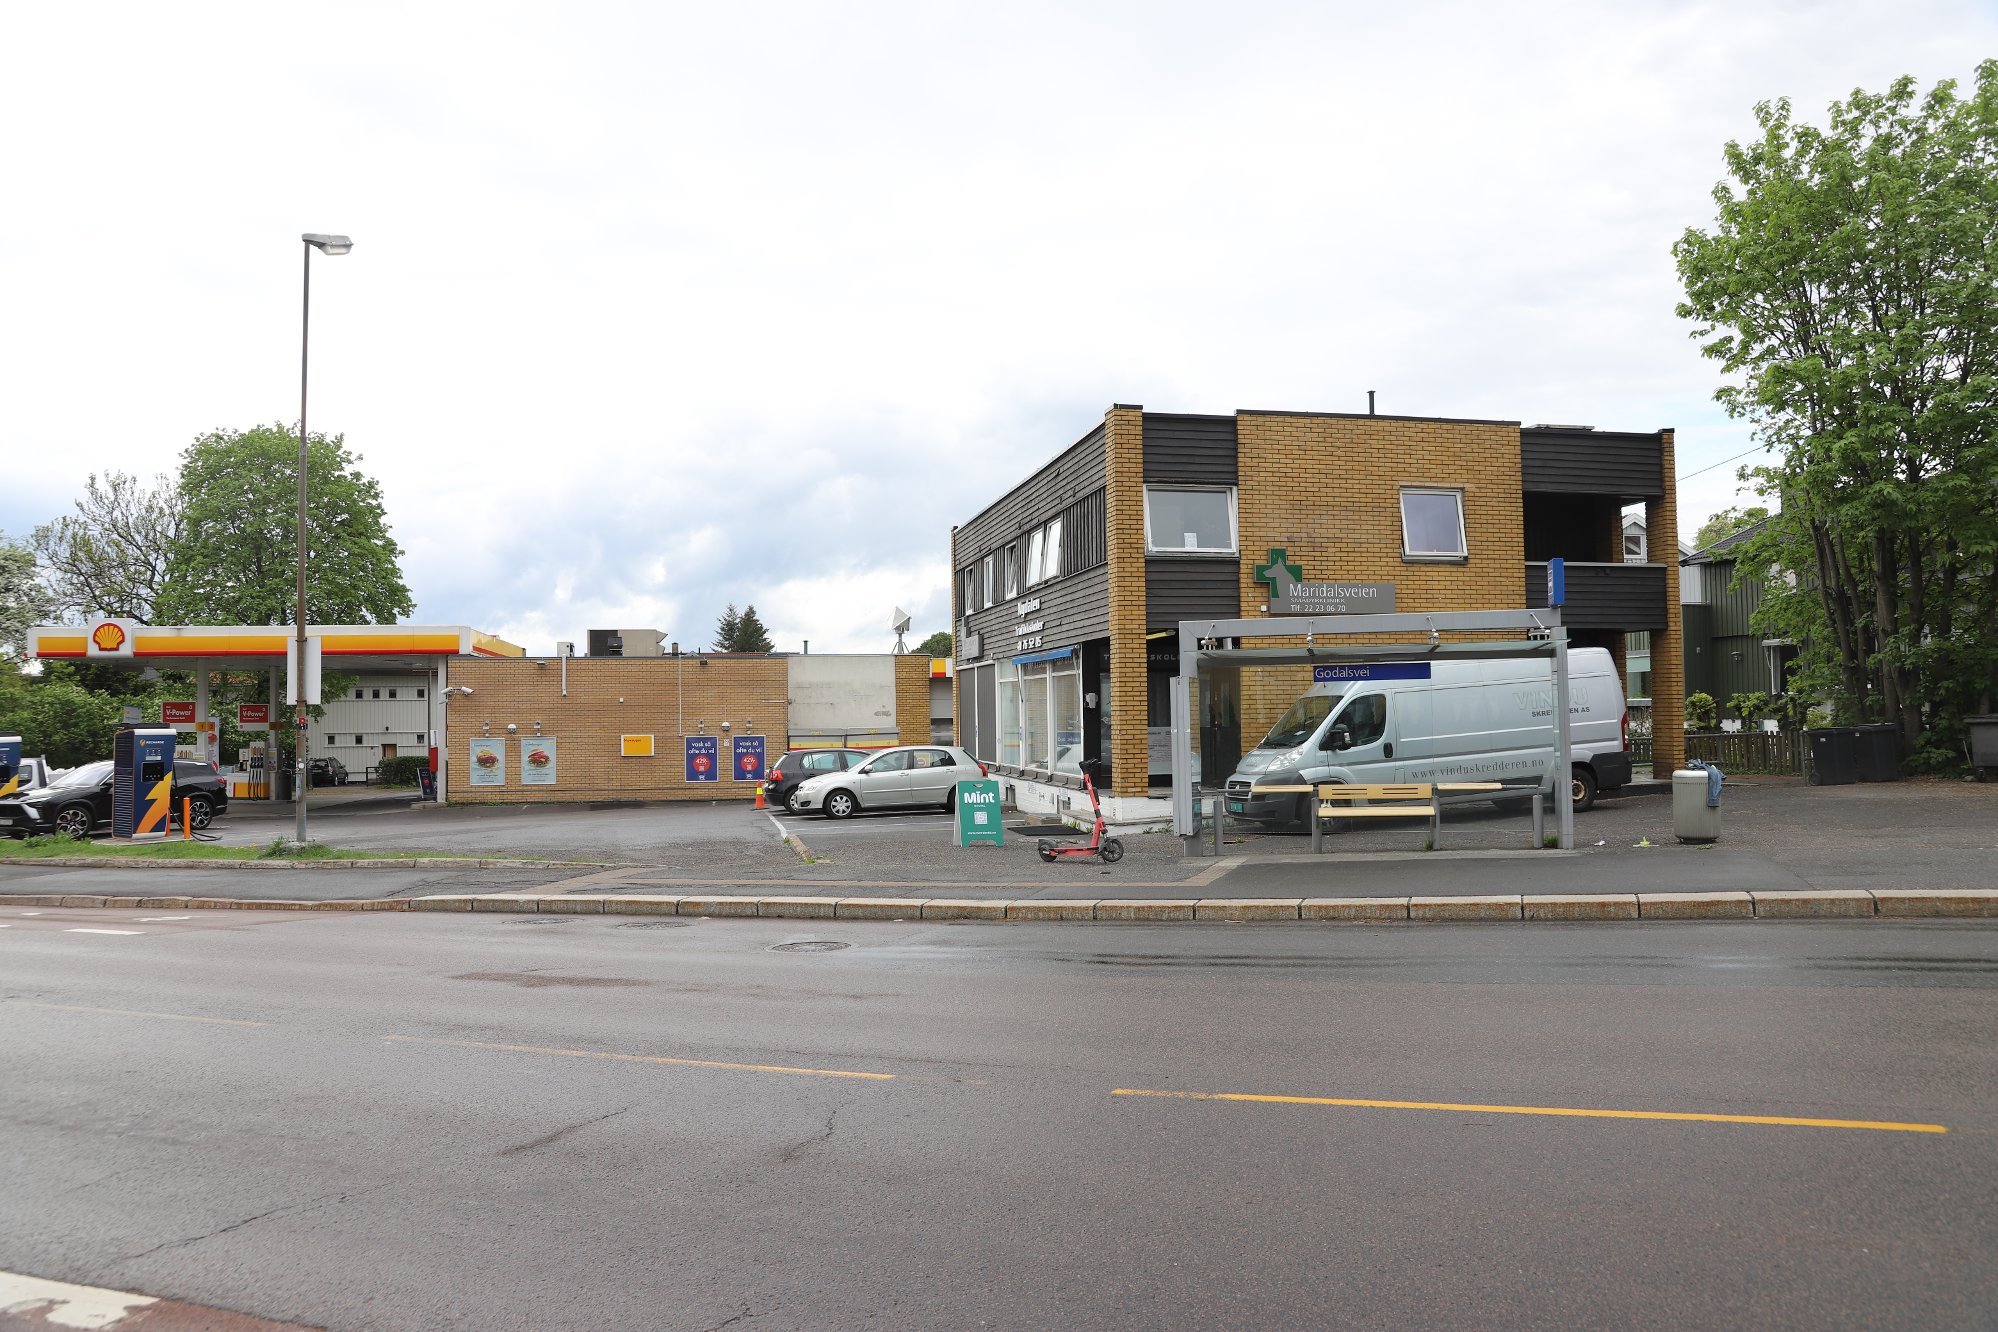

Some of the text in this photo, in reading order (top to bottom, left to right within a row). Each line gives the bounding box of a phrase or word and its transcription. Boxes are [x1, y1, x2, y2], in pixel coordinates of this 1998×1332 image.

[1289, 584, 1377, 598] Maridalsveien
[1337, 604, 1346, 612] 70
[1315, 666, 1370, 678] Godalsvei
[1580, 706, 1591, 714] AS
[1411, 759, 1544, 779] www.vinduskredderen.no
